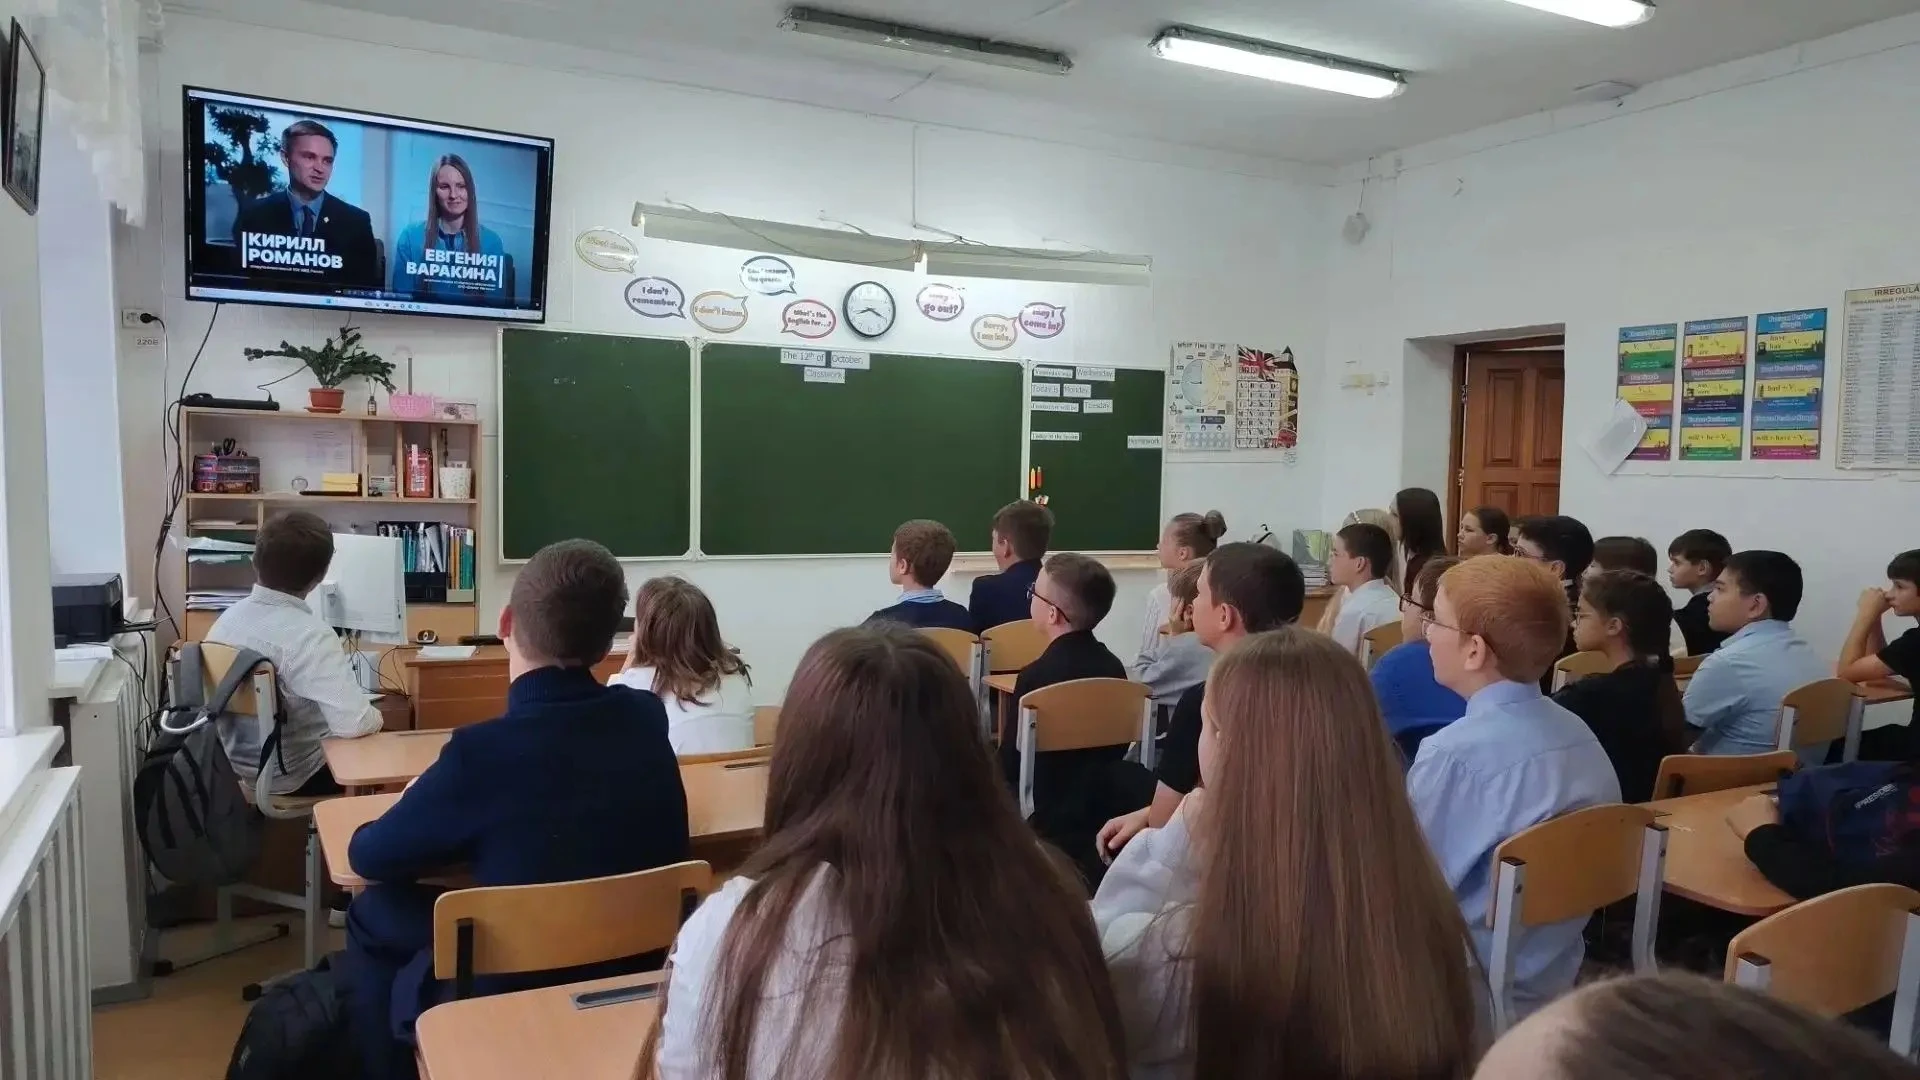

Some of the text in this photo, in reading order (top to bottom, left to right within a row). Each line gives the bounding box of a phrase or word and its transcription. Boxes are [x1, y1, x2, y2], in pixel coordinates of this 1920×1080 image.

[248, 232, 325, 252] КИРИЛЛ
[248, 248, 343, 269] РОМАНОВ
[425, 248, 498, 267] ЕВГЕНИЯ
[406, 261, 496, 281] ВАРАКИНА
[646, 286, 669, 295] don't
[632, 297, 678, 307] remember.
[699, 306, 721, 315] don't
[794, 309, 827, 319] What's the
[924, 303, 959, 315] go out?
[788, 317, 811, 327] English
[1023, 319, 1047, 329] come
[783, 351, 798, 360] The
[800, 351, 815, 361] 12th
[816, 353, 825, 362] of
